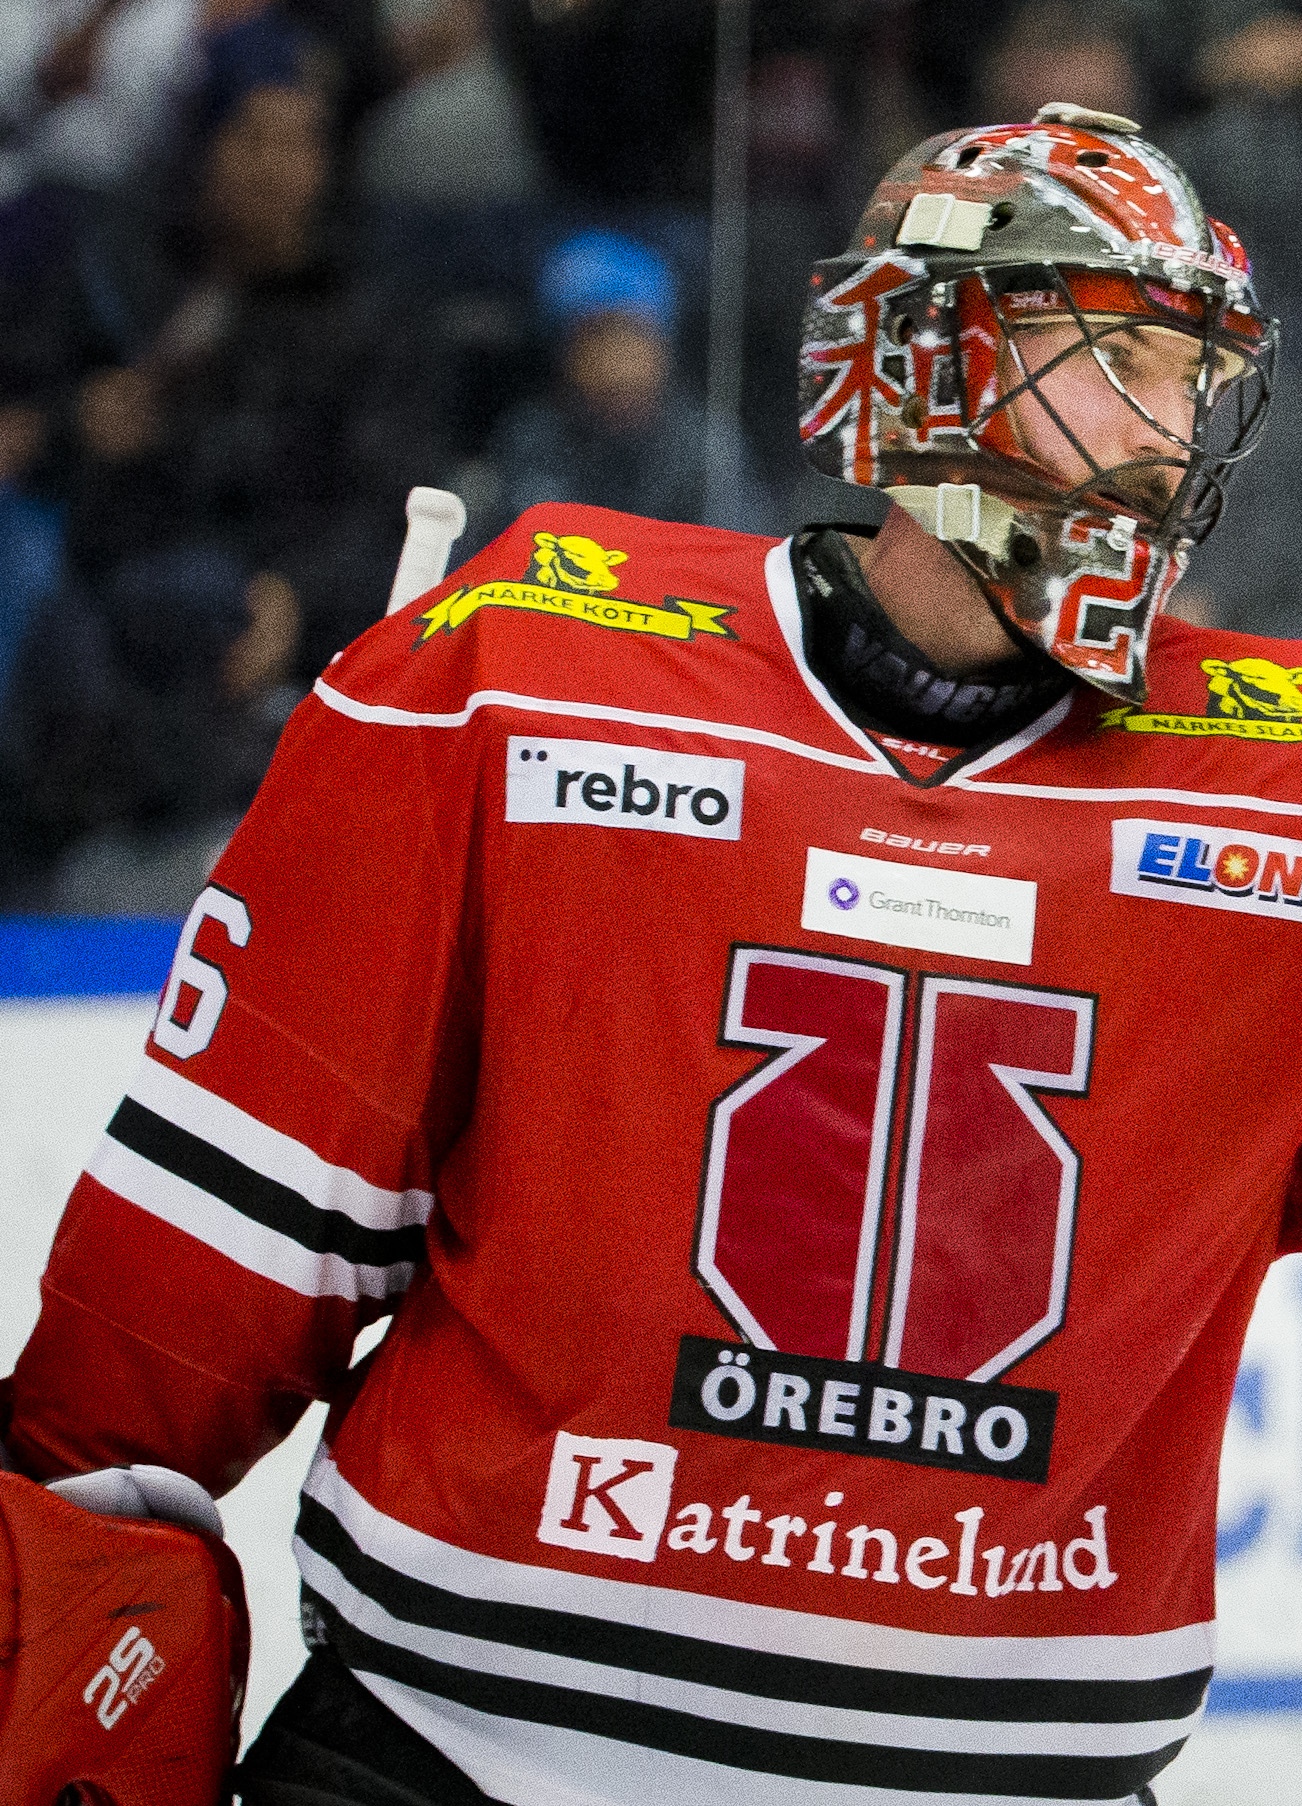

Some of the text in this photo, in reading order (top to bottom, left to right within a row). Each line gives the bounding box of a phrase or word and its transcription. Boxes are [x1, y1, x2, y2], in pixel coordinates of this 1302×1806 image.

[153, 881, 252, 1060] 6
[869, 890, 1011, 929] Grant Thornton
[701, 1350, 1029, 1462] ÖREBRO
[558, 1453, 1118, 1598] Katrinelund
